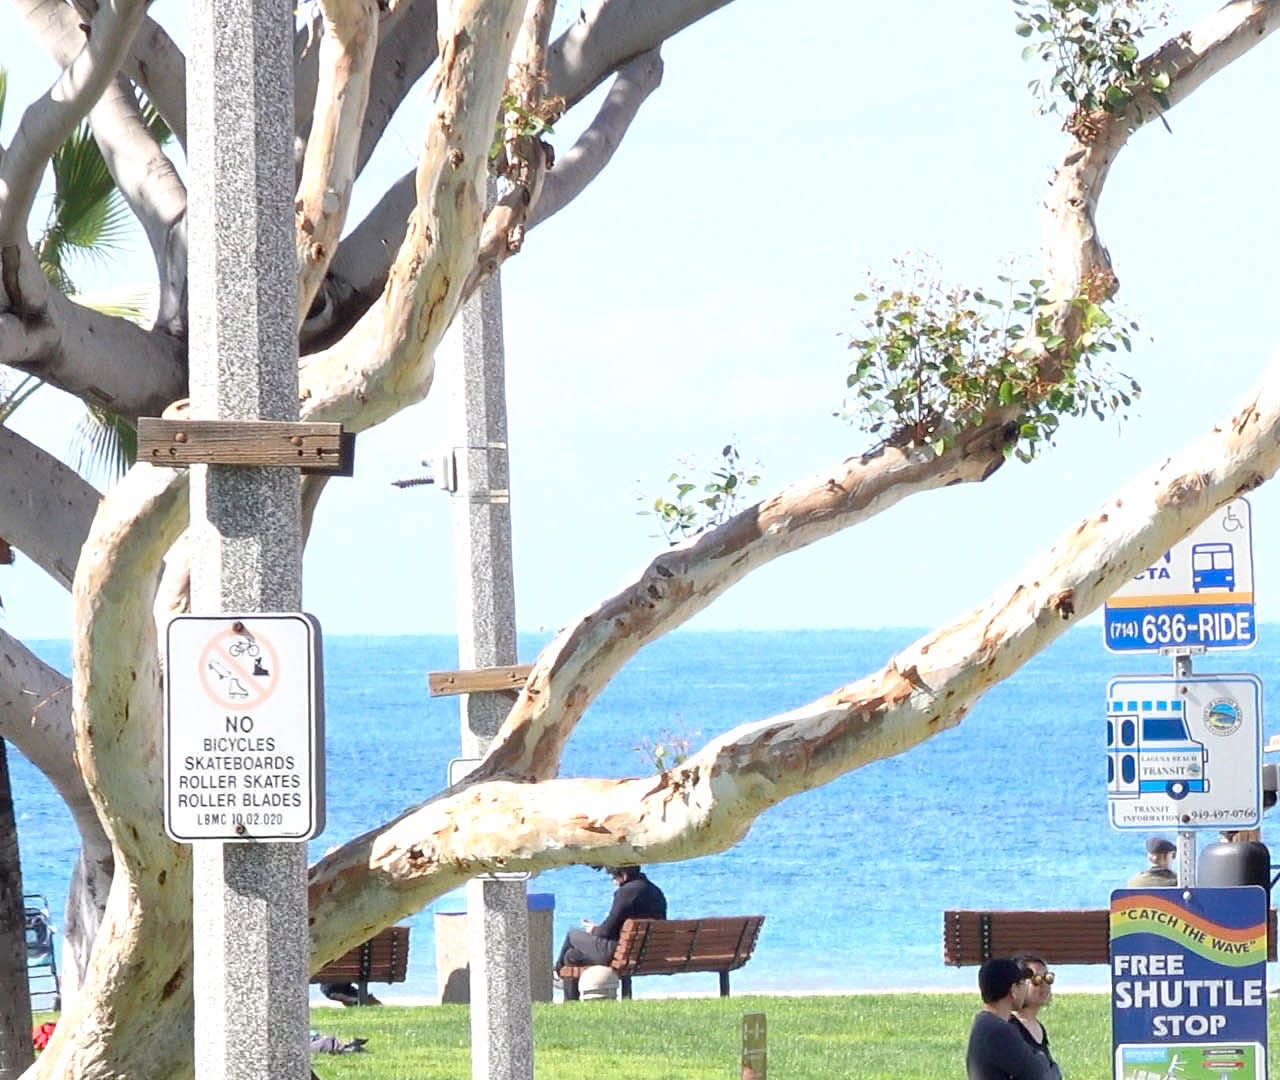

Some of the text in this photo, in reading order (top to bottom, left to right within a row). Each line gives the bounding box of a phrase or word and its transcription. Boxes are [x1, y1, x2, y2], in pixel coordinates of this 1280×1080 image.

[1110, 611, 1251, 644] (714) 636-RIDE
[225, 716, 254, 733] NO
[203, 737, 275, 752] BICYCLES
[184, 756, 295, 771] SKATEBOARDS
[1143, 766, 1186, 776] TRANSIT
[179, 774, 301, 789] ROLLER SKATES
[178, 793, 302, 808] ROLLER BLADES
[197, 813, 227, 826] LBMC
[1123, 815, 1180, 823] INFORMATION
[1191, 808, 1257, 819] 949-497-0766
[1120, 909, 1257, 954] "CATCH THE WAVE"
[1114, 954, 1185, 976] FREE
[1115, 979, 1263, 1009] SHUTTLE
[1152, 1014, 1226, 1036] STOP
